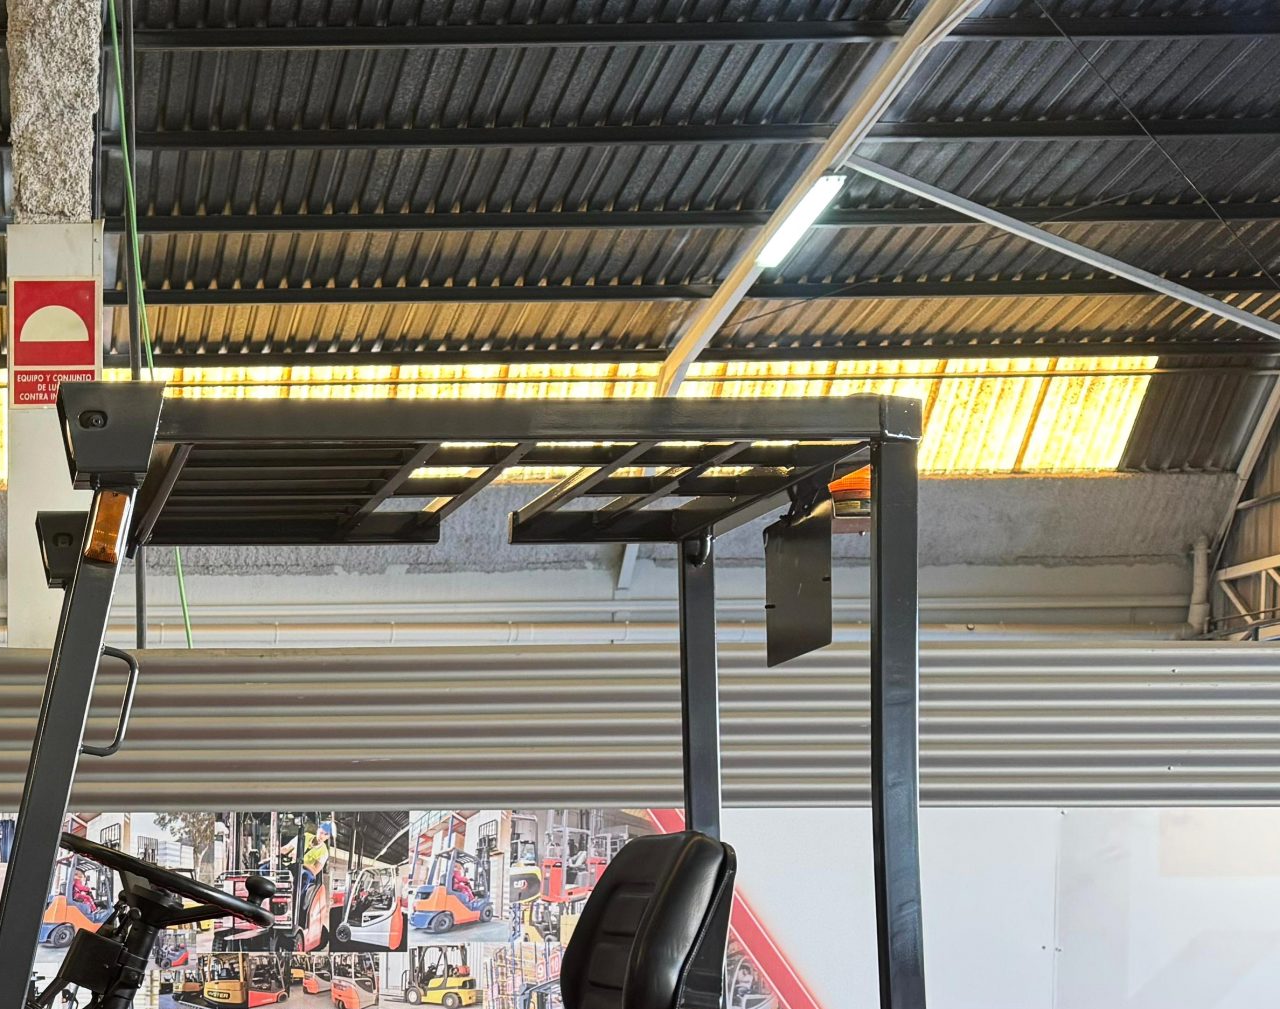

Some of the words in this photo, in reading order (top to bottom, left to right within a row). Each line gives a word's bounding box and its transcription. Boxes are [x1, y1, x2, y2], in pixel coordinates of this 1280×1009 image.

[17, 374, 44, 382] EQUIPO
[46, 374, 51, 382] Y
[53, 374, 91, 382] CONJUNTO
